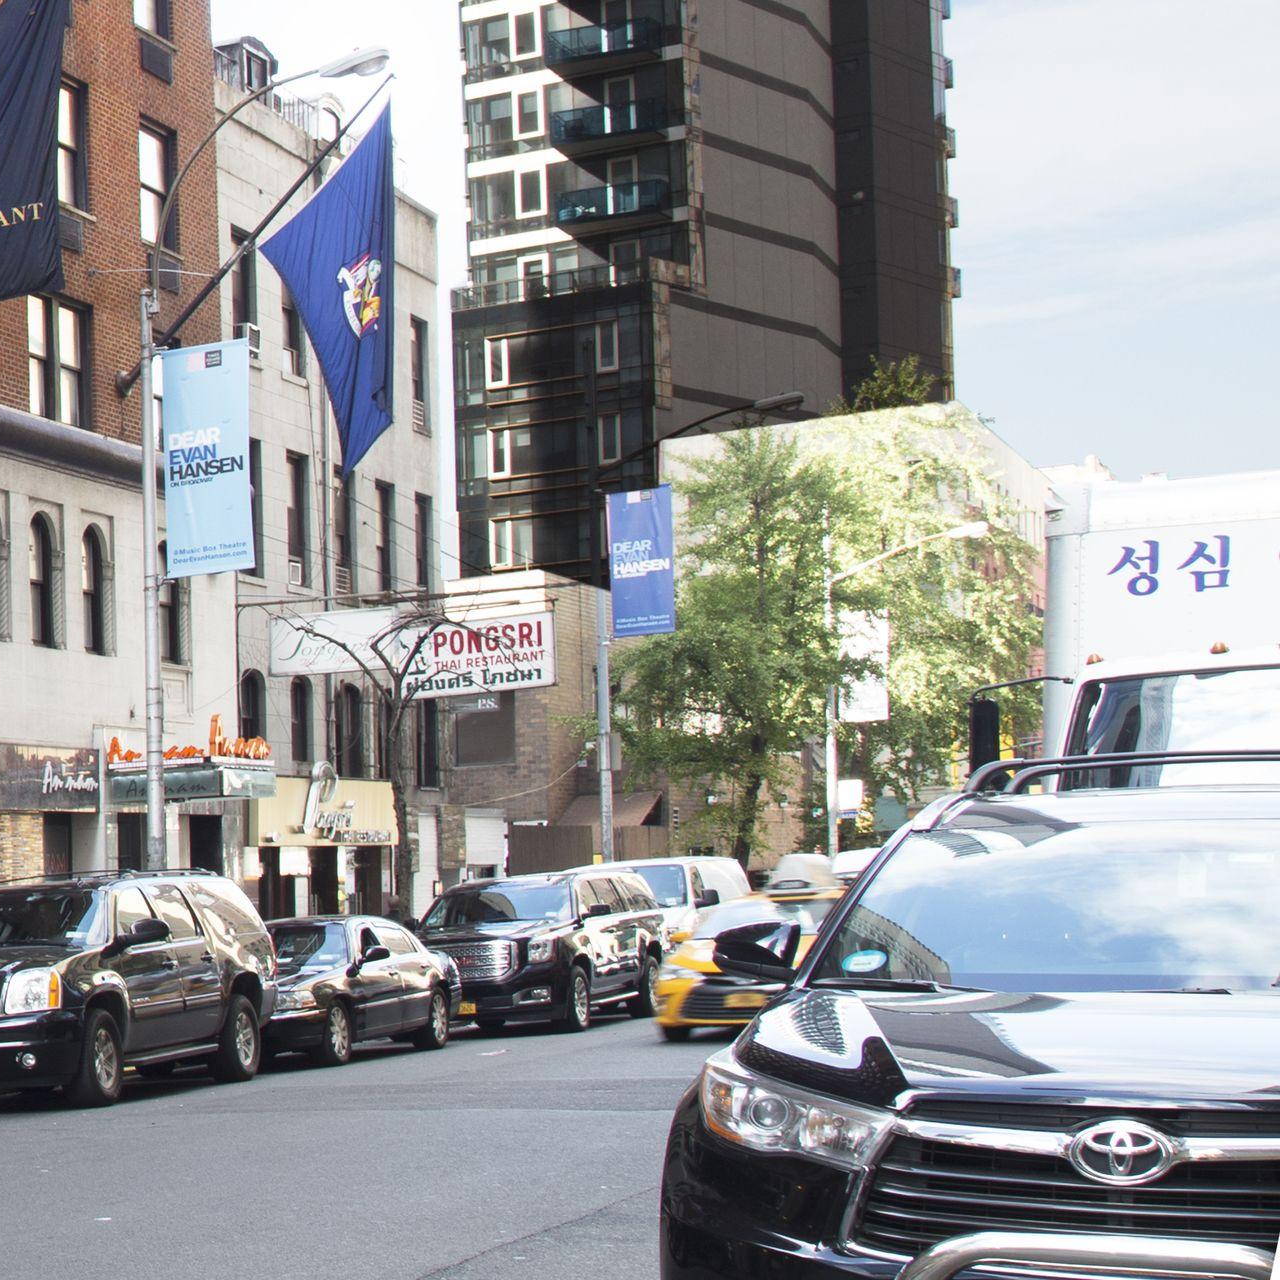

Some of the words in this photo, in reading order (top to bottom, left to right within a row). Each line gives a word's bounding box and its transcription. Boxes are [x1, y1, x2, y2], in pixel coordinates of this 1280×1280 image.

[168, 426, 221, 451] DEAR
[169, 443, 217, 466] EVAN
[169, 455, 244, 482] HANSEN
[613, 539, 652, 554] DEAR
[613, 551, 649, 564] EVAN
[613, 558, 670, 576] HANSEN
[433, 621, 542, 658] PONGSRI
[434, 660, 461, 672] THAI
[466, 650, 546, 669] RESTAURANT
